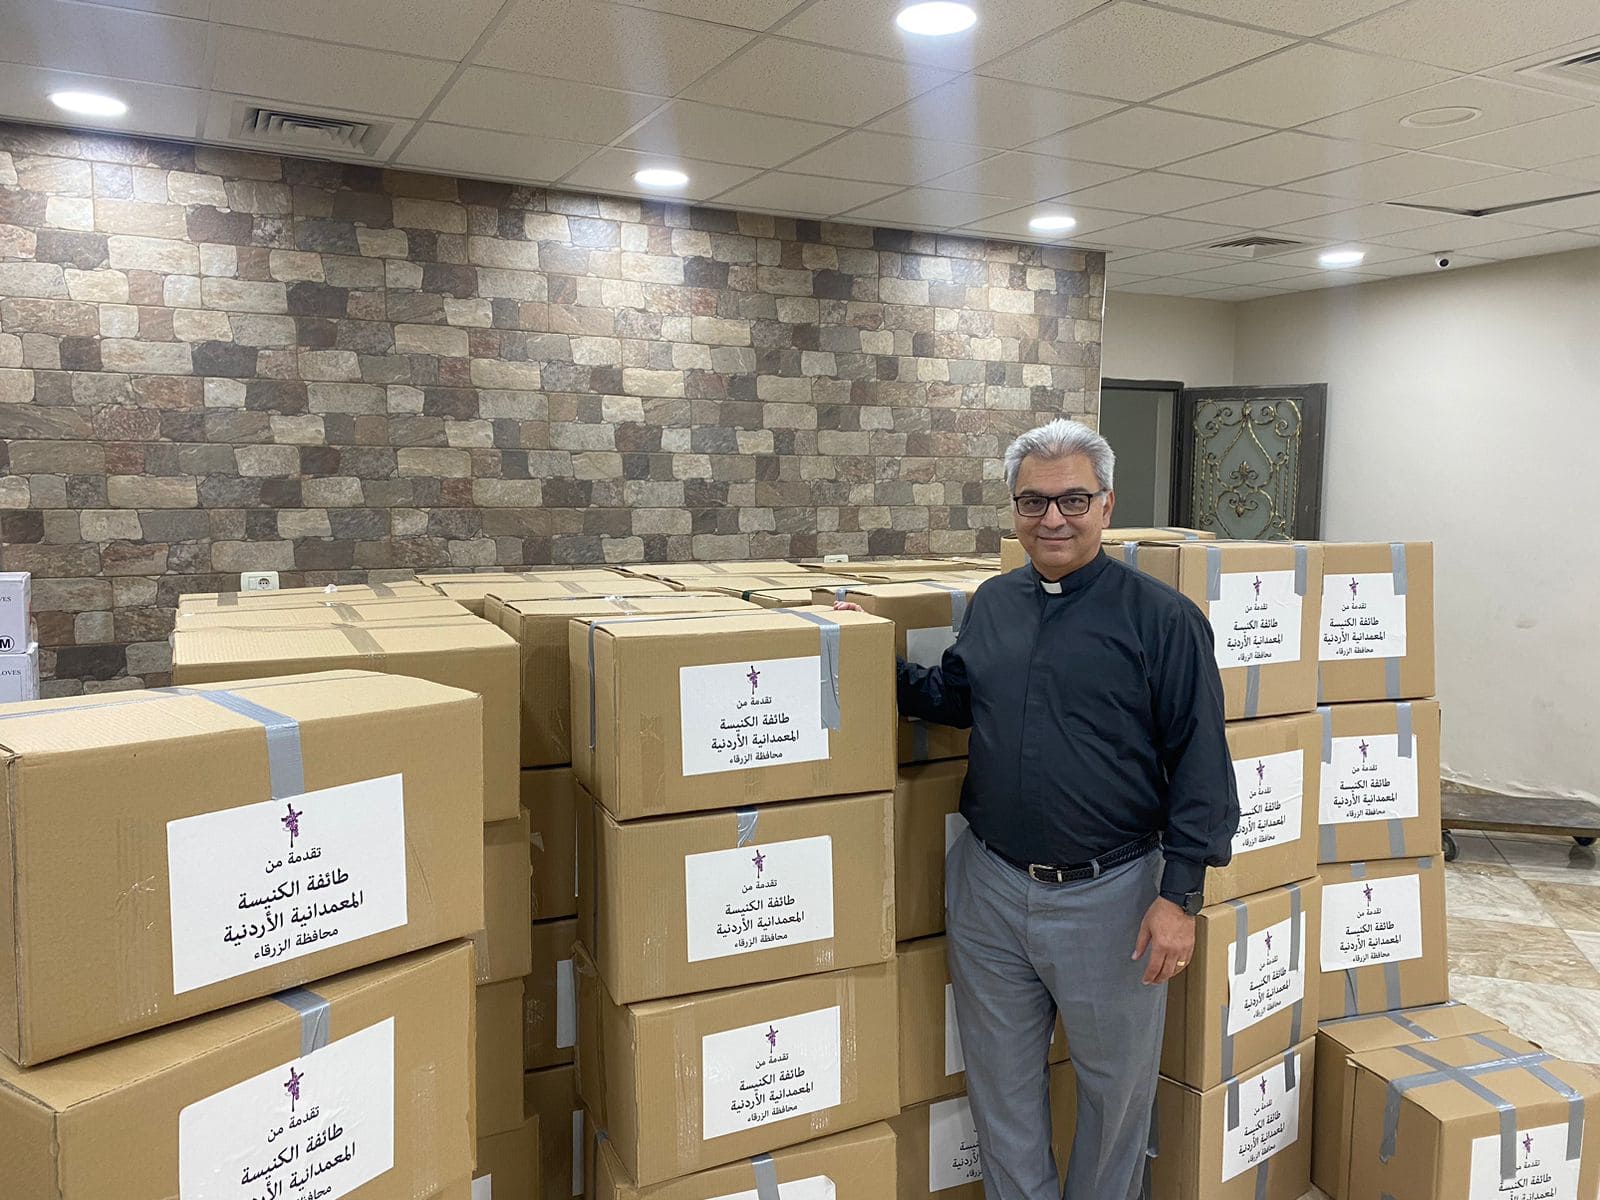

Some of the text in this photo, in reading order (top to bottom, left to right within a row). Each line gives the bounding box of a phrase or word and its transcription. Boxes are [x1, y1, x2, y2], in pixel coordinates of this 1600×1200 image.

[1245, 605, 1252, 613] من
[1234, 619, 1278, 633] طائفة الكنيسة
[1330, 617, 1379, 629] طائفة الكنيسة
[0, 639, 10, 648] M
[1227, 634, 1283, 650] المعمدانية الأردنية
[1324, 631, 1385, 645] المعمدانية الأردنية
[1238, 653, 1252, 662] الزرقاء
[1336, 647, 1352, 656] الزرقاء
[736, 697, 772, 709] تقدمة من
[720, 713, 790, 732] طائفة الكنيسة
[711, 730, 799, 752] المعمدانية الأردنية
[730, 751, 783, 764] محافظة الزرقاء
[1340, 778, 1390, 792] طائفة الكنيسة
[1265, 800, 1281, 812] طائفة
[1333, 793, 1397, 808] المعمدانية الأردنية
[1347, 810, 1363, 818] الزرقاء
[1236, 815, 1285, 837] المعمدانية الأردني
[265, 847, 322, 873] تقدمة من
[238, 868, 349, 910] طائفة الكنيسة
[742, 880, 777, 893] تقدمة من
[725, 895, 795, 916] طائفة الكنيسة
[223, 891, 363, 946] المعمدانية الأردنية
[716, 911, 804, 938] المعمدانية الأردنية
[1346, 921, 1394, 936] طائفة الكنيسة
[254, 928, 339, 961] محافظة الزرقاء
[735, 933, 787, 948] محافظة الزرقاء
[1340, 935, 1401, 953] المعمدانية الأردنية
[1353, 953, 1369, 962] الزرقاء
[755, 1053, 789, 1069] تقدمة من
[740, 1067, 805, 1092] طائفة الكنيسة
[731, 1082, 814, 1113] المعمدانية الأردنية
[748, 1105, 798, 1122] محافظة الزرقاء
[267, 1106, 320, 1142] تقدمة من
[241, 1123, 343, 1185] طائفة الكنيسة
[952, 1152, 978, 1169] لأردنية
[289, 1142, 356, 1192] المعمدانية
[1524, 1160, 1540, 1169] تقدمة
[1499, 1173, 1551, 1193] طائفة الكنيسة
